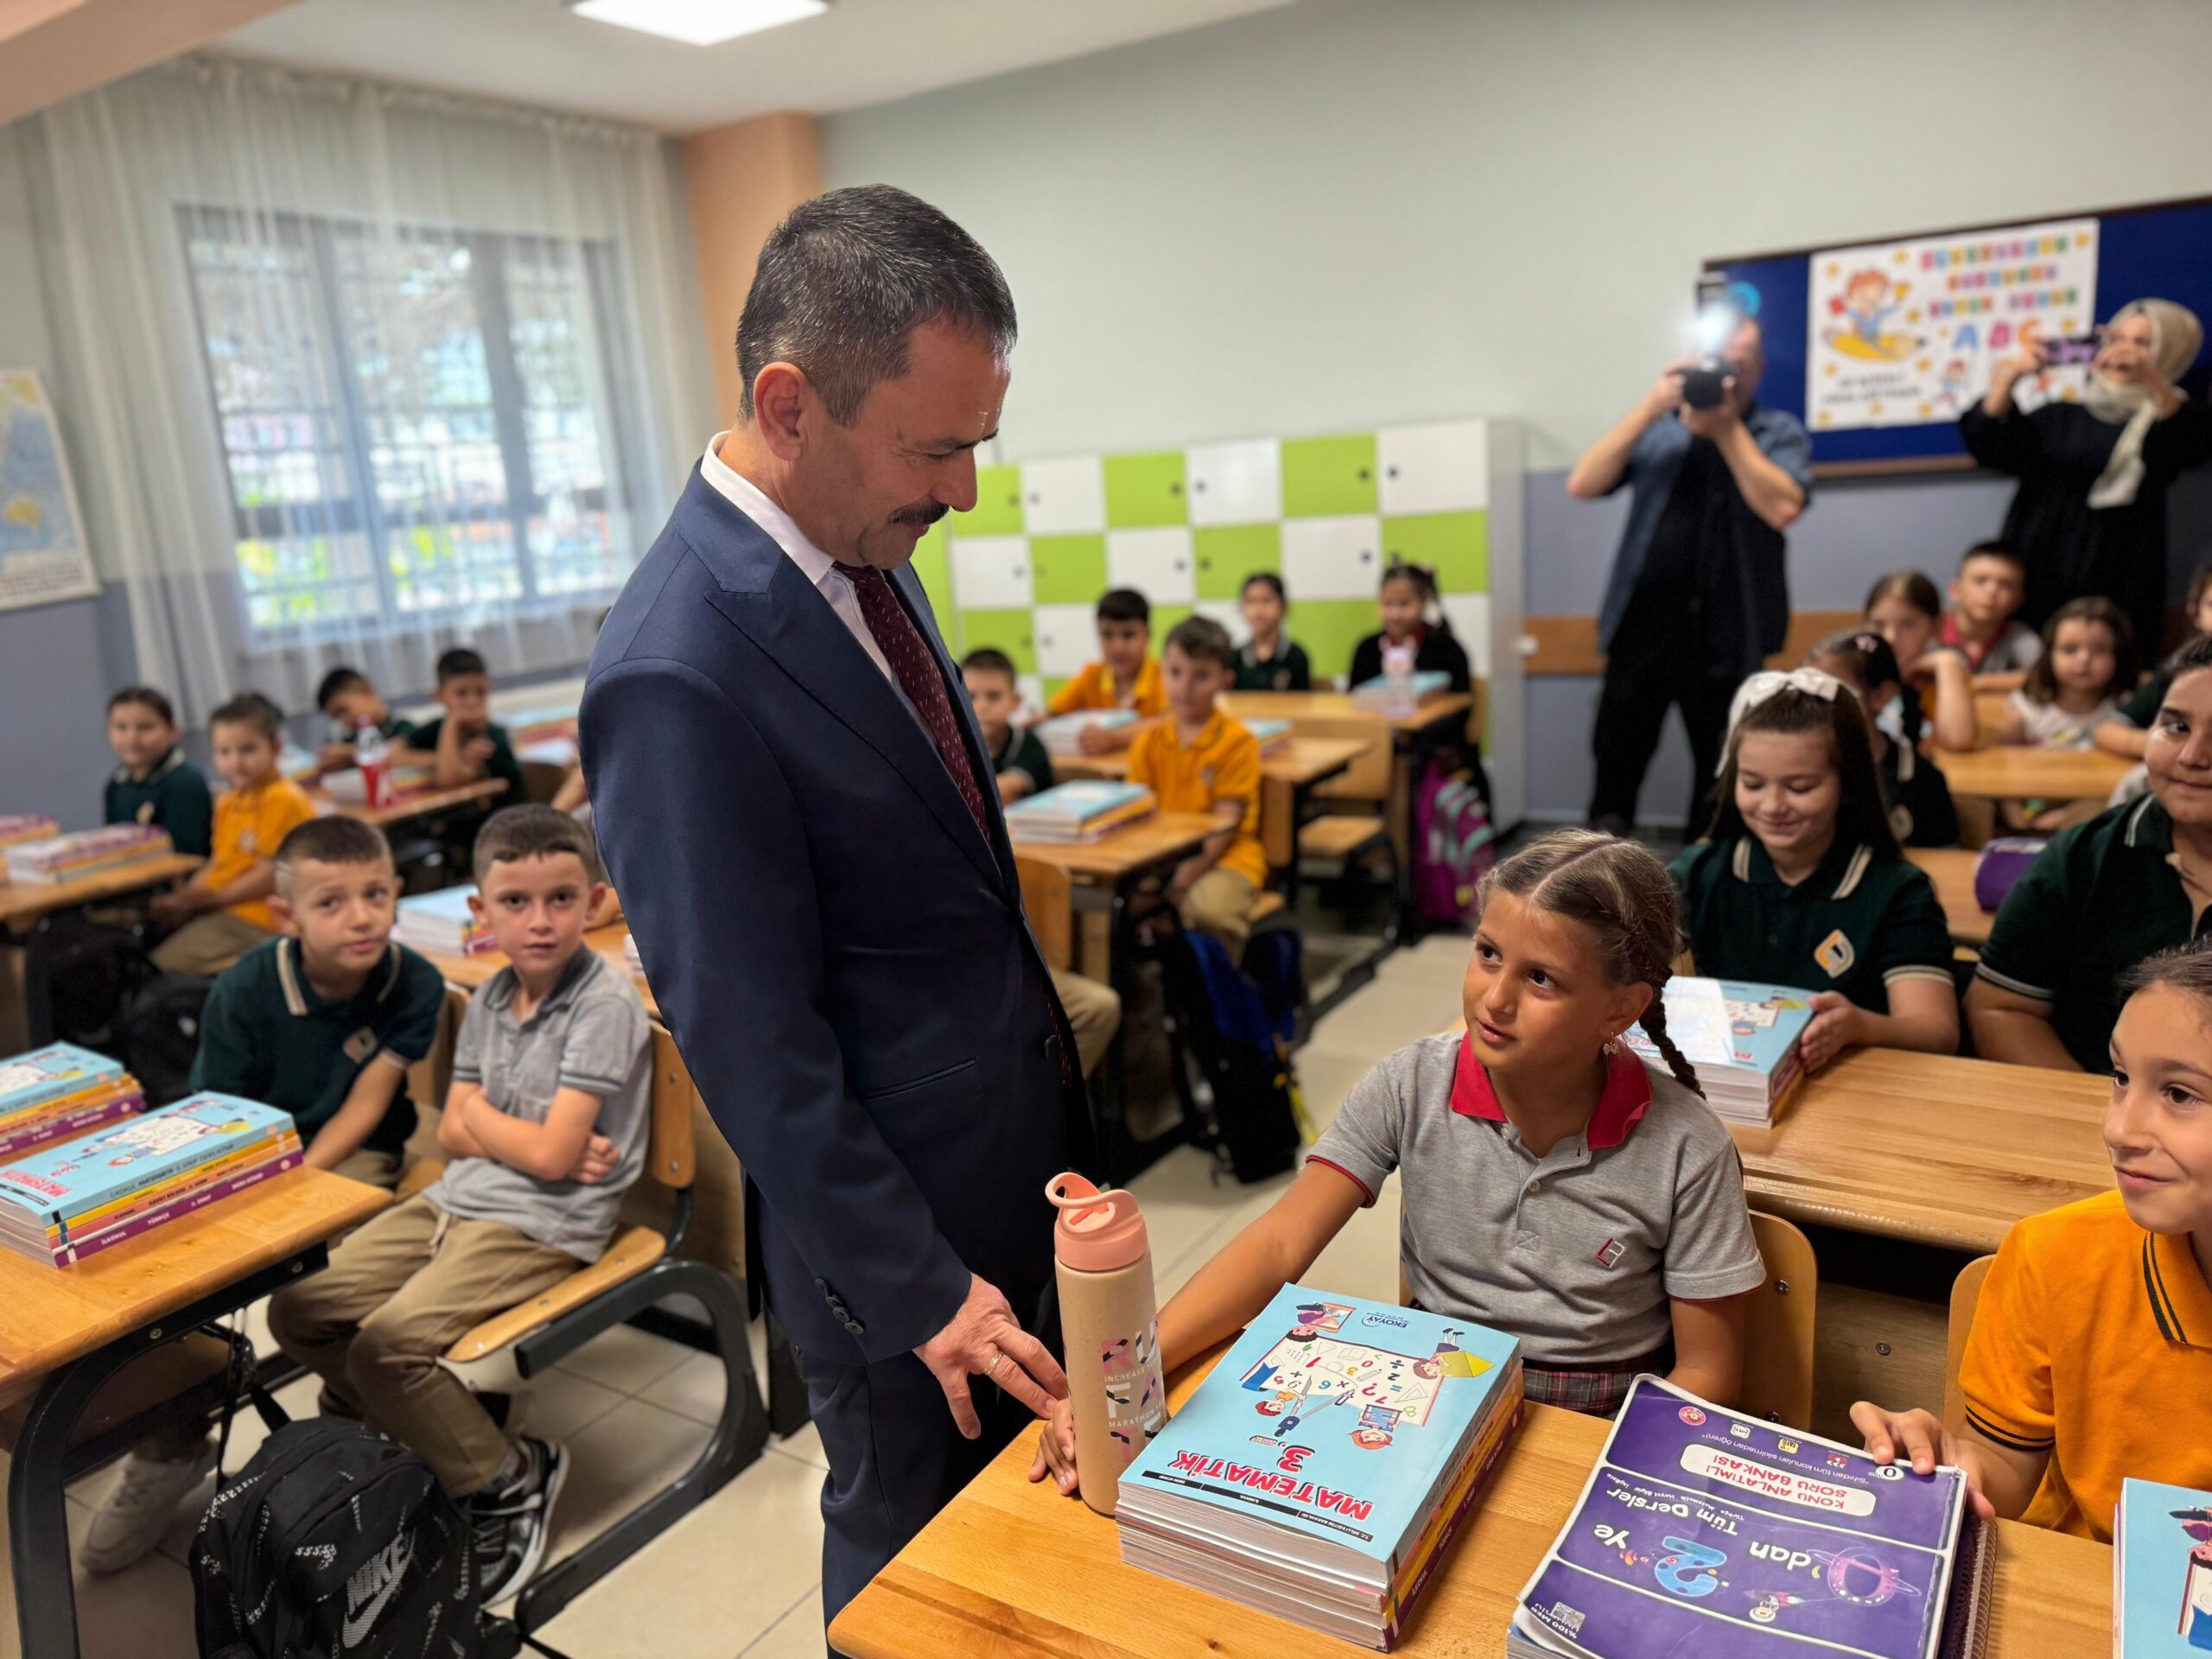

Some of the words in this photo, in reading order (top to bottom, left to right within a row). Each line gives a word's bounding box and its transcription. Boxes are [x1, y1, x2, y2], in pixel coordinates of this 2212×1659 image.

[1366, 1316, 1408, 1328] EKOYAY
[1278, 1442, 1314, 1473] 3.
[1713, 1454, 1791, 1486] BANKASI
[1814, 1466, 1831, 1475] tüm
[1169, 1452, 1374, 1521] MATEMATİK
[1706, 1465, 1793, 1497] ANLATIMLI
[1797, 1480, 1847, 1498] SORU
[1605, 1487, 1688, 1517] Dersler
[1796, 1492, 1845, 1510] KONU
[1696, 1508, 1738, 1535] Tüm
[346, 1532, 407, 1615] NIKE
[1654, 1535, 1727, 1598] 2
